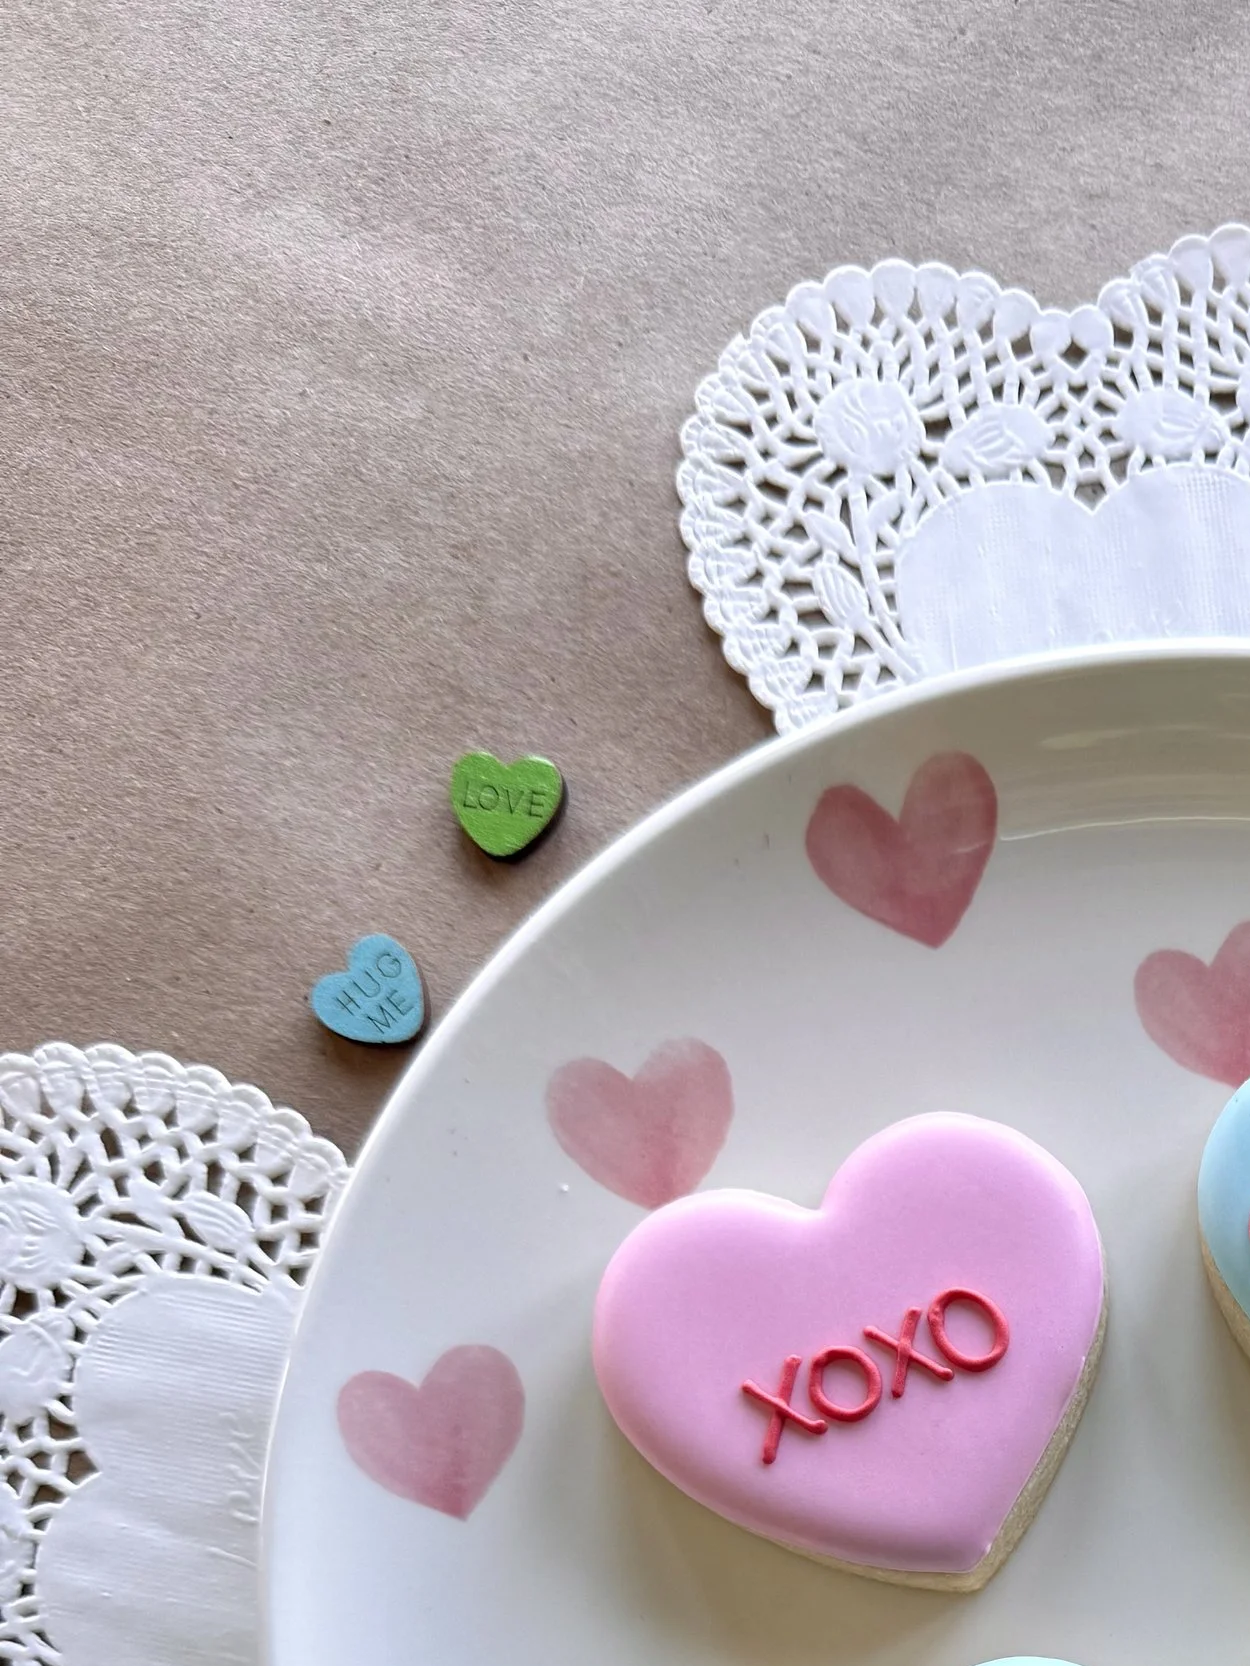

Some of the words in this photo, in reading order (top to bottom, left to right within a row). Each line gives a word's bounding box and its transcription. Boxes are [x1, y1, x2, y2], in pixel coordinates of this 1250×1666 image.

[463, 782, 547, 818] LOVE
[334, 953, 402, 1016] HUG
[363, 989, 414, 1034] ME
[741, 1287, 1010, 1464] XOXO
